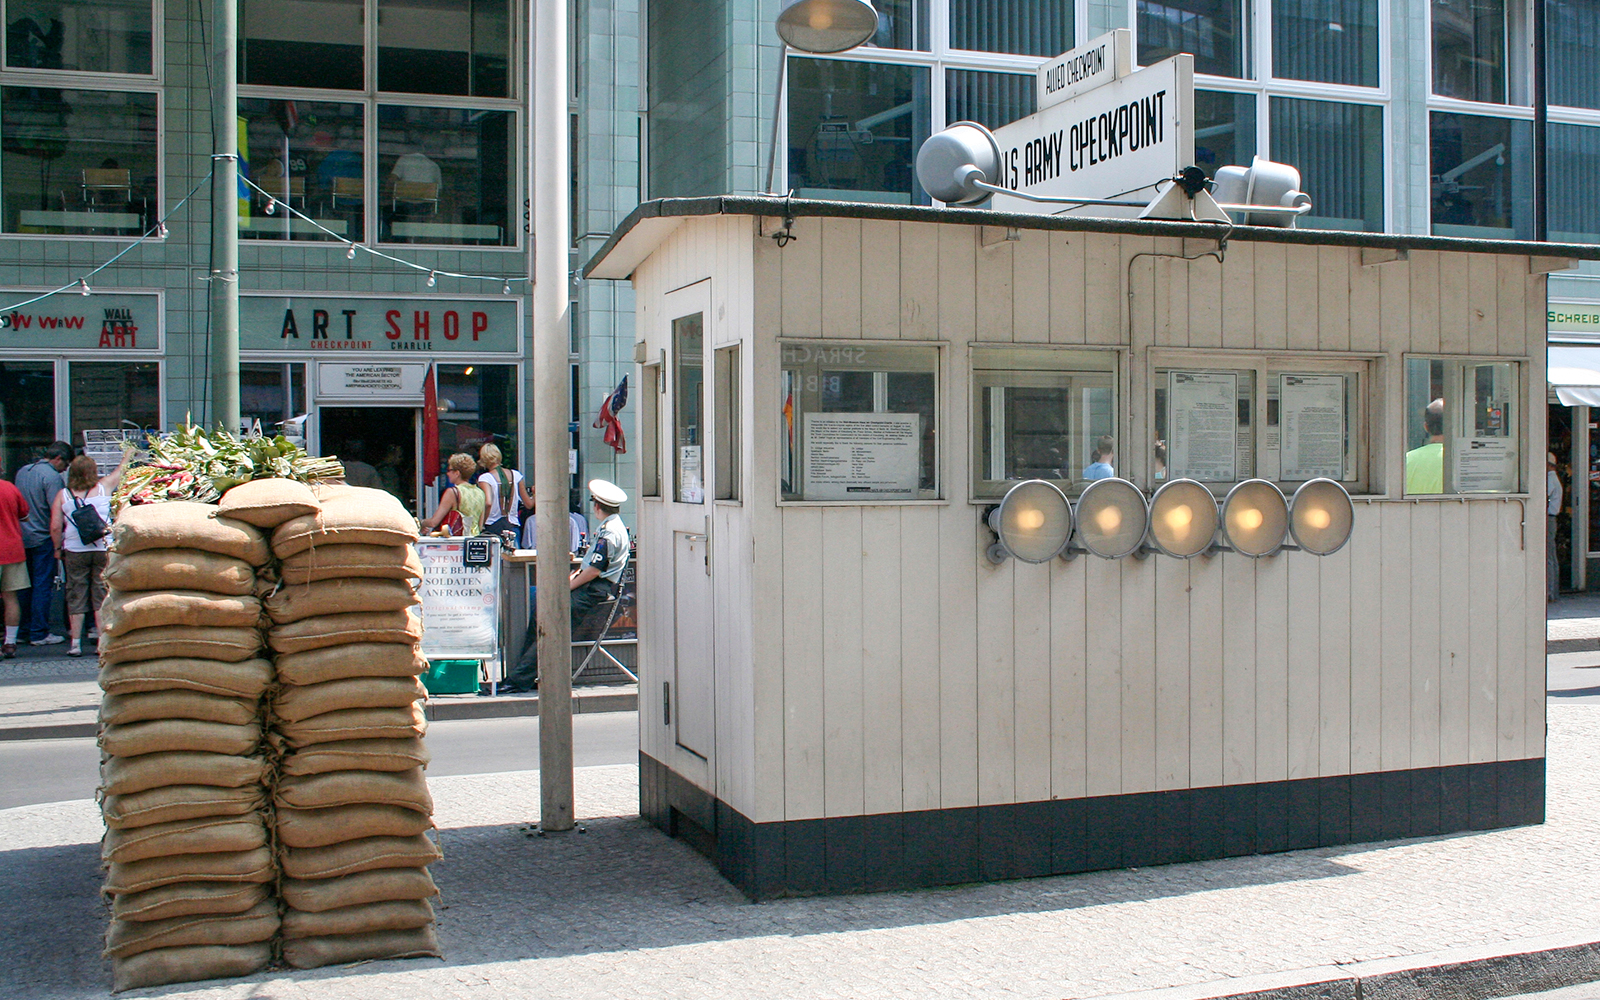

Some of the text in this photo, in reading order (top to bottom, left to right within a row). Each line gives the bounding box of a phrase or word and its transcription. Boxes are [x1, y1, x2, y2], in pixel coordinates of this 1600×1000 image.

[1045, 44, 1106, 96] ALLIED CHECKPOINT
[1025, 129, 1063, 187] ARMY
[1070, 90, 1166, 171] CHECKPOINT
[104, 308, 132, 320] WALL
[280, 308, 488, 341] ART SHOP
[98, 326, 139, 348] ART
[310, 340, 433, 350] CHECKPOINT CHARLIE
[423, 566, 448, 575] ITTE
[425, 577, 482, 586] SOLDATEN
[424, 588, 483, 597] ANFRAGEN
